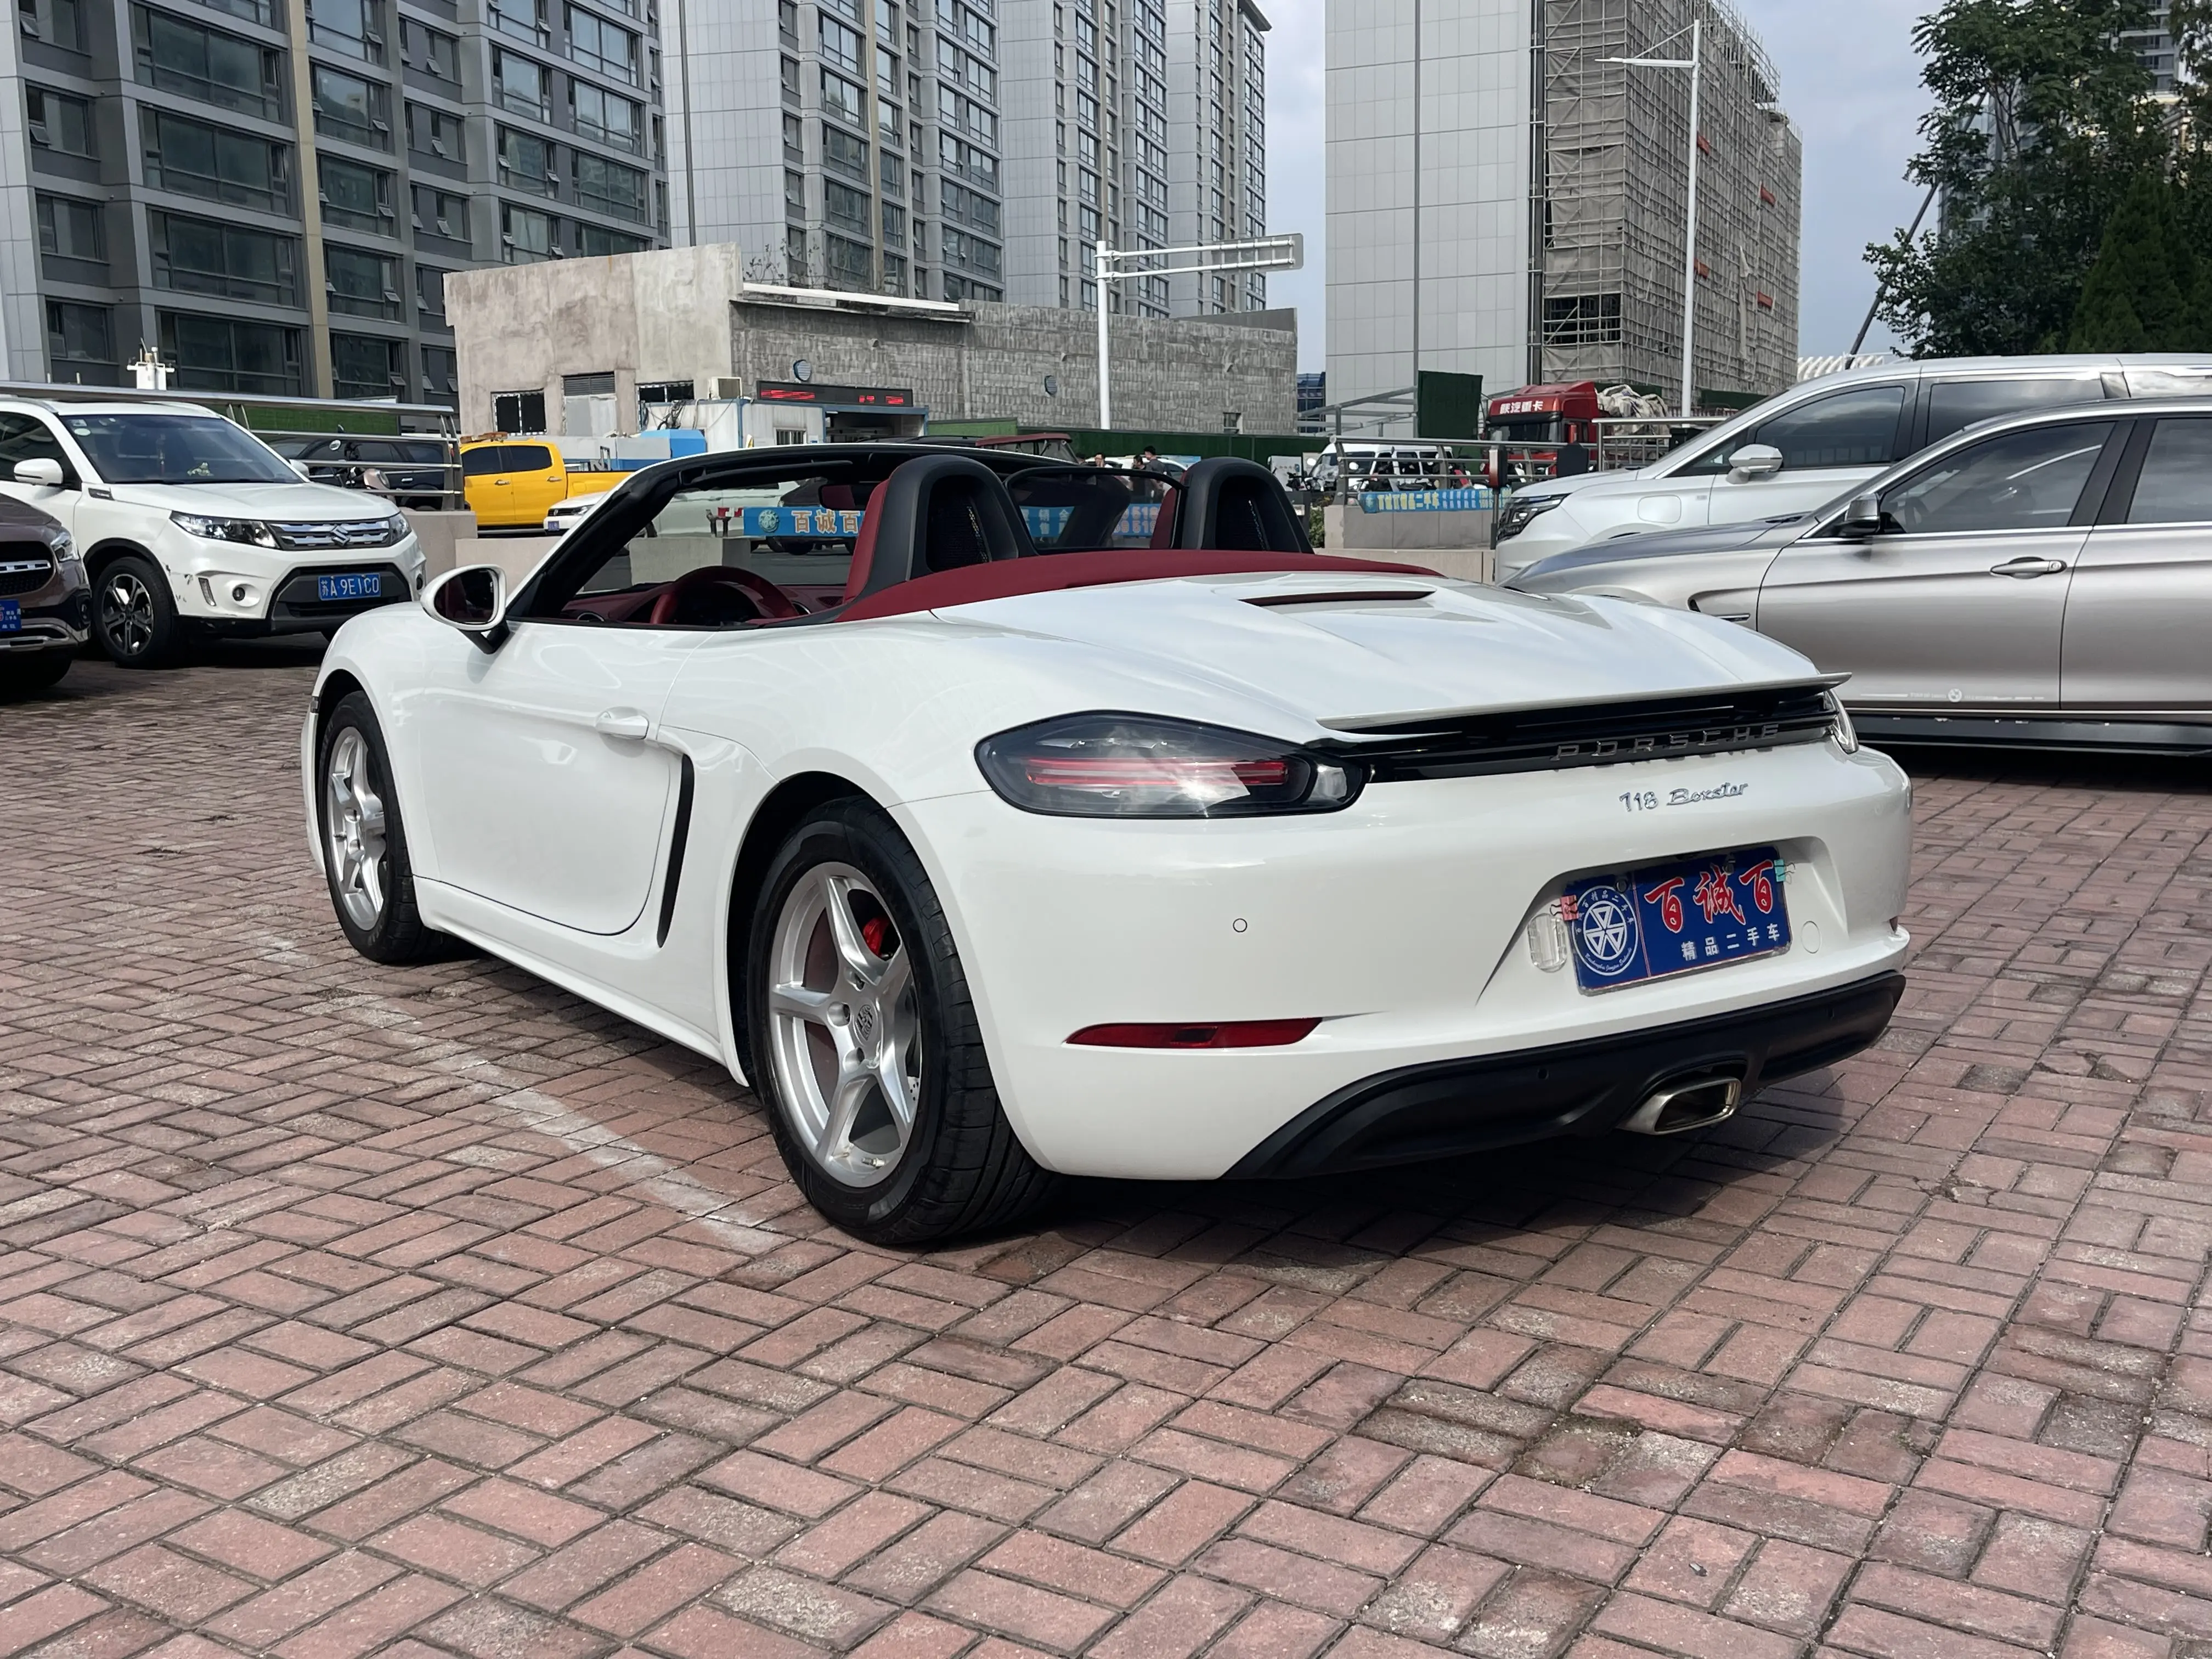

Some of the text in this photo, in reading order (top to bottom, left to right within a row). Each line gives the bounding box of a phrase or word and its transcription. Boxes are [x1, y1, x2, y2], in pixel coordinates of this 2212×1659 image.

[791, 509, 861, 534] 百诚百
[1550, 724, 1779, 761] PORSCHE
[1619, 782, 1748, 812] 718 Boxster
[1644, 859, 1774, 933] 百诚百
[1681, 923, 1780, 961] 精品二手车
